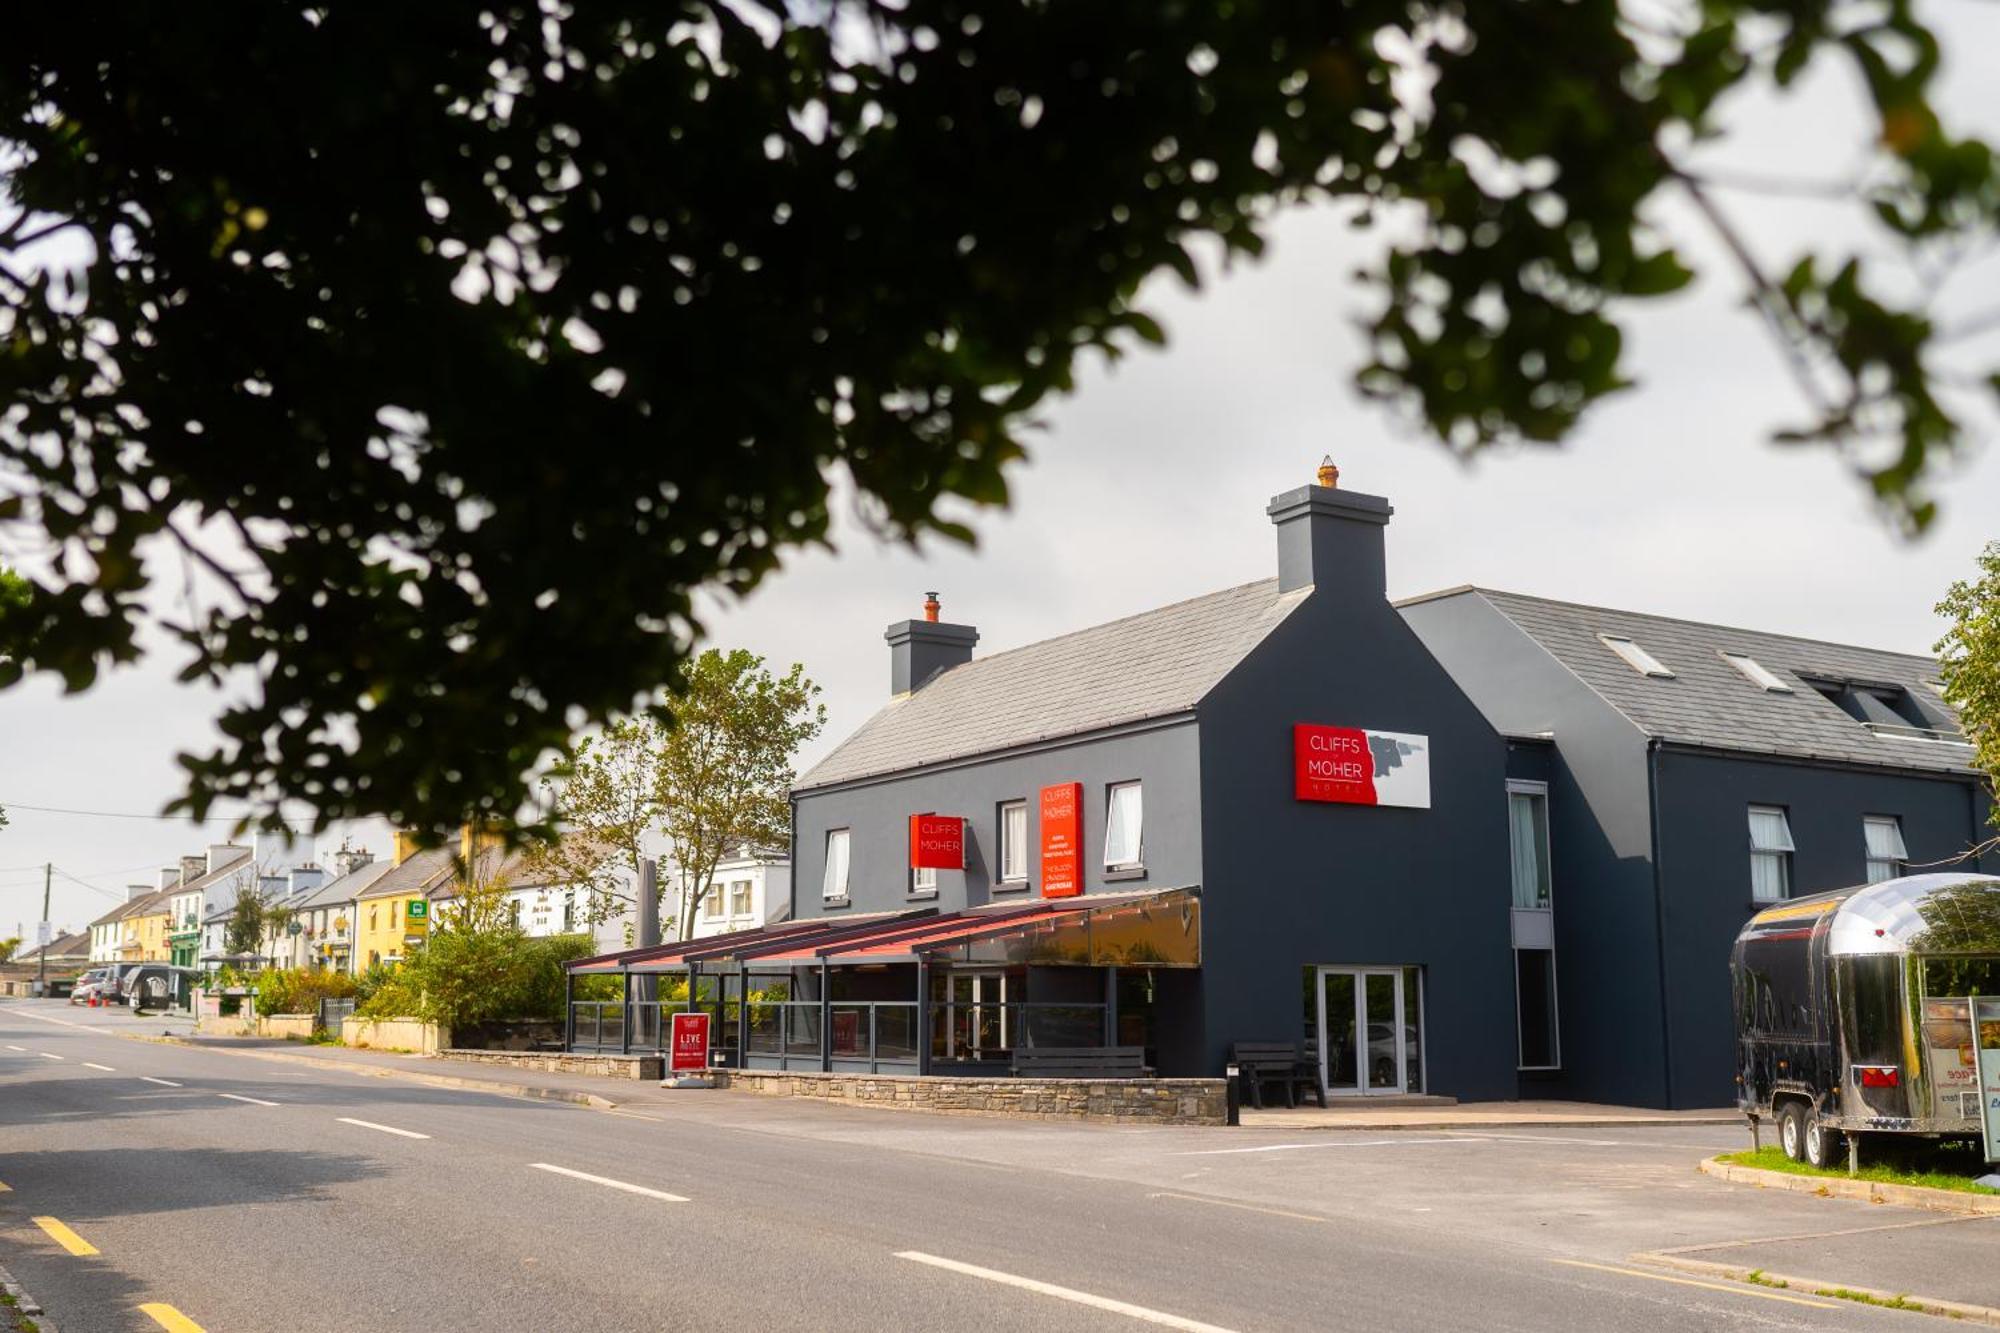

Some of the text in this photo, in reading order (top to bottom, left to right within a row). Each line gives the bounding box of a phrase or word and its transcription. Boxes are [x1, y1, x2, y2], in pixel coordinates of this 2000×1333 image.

[1310, 735, 1360, 754] CLIFFS
[1308, 760, 1363, 778] MOHER
[921, 823, 960, 836] CLIFFS
[920, 840, 961, 852] MOHER
[680, 1033, 701, 1043] LIVE
